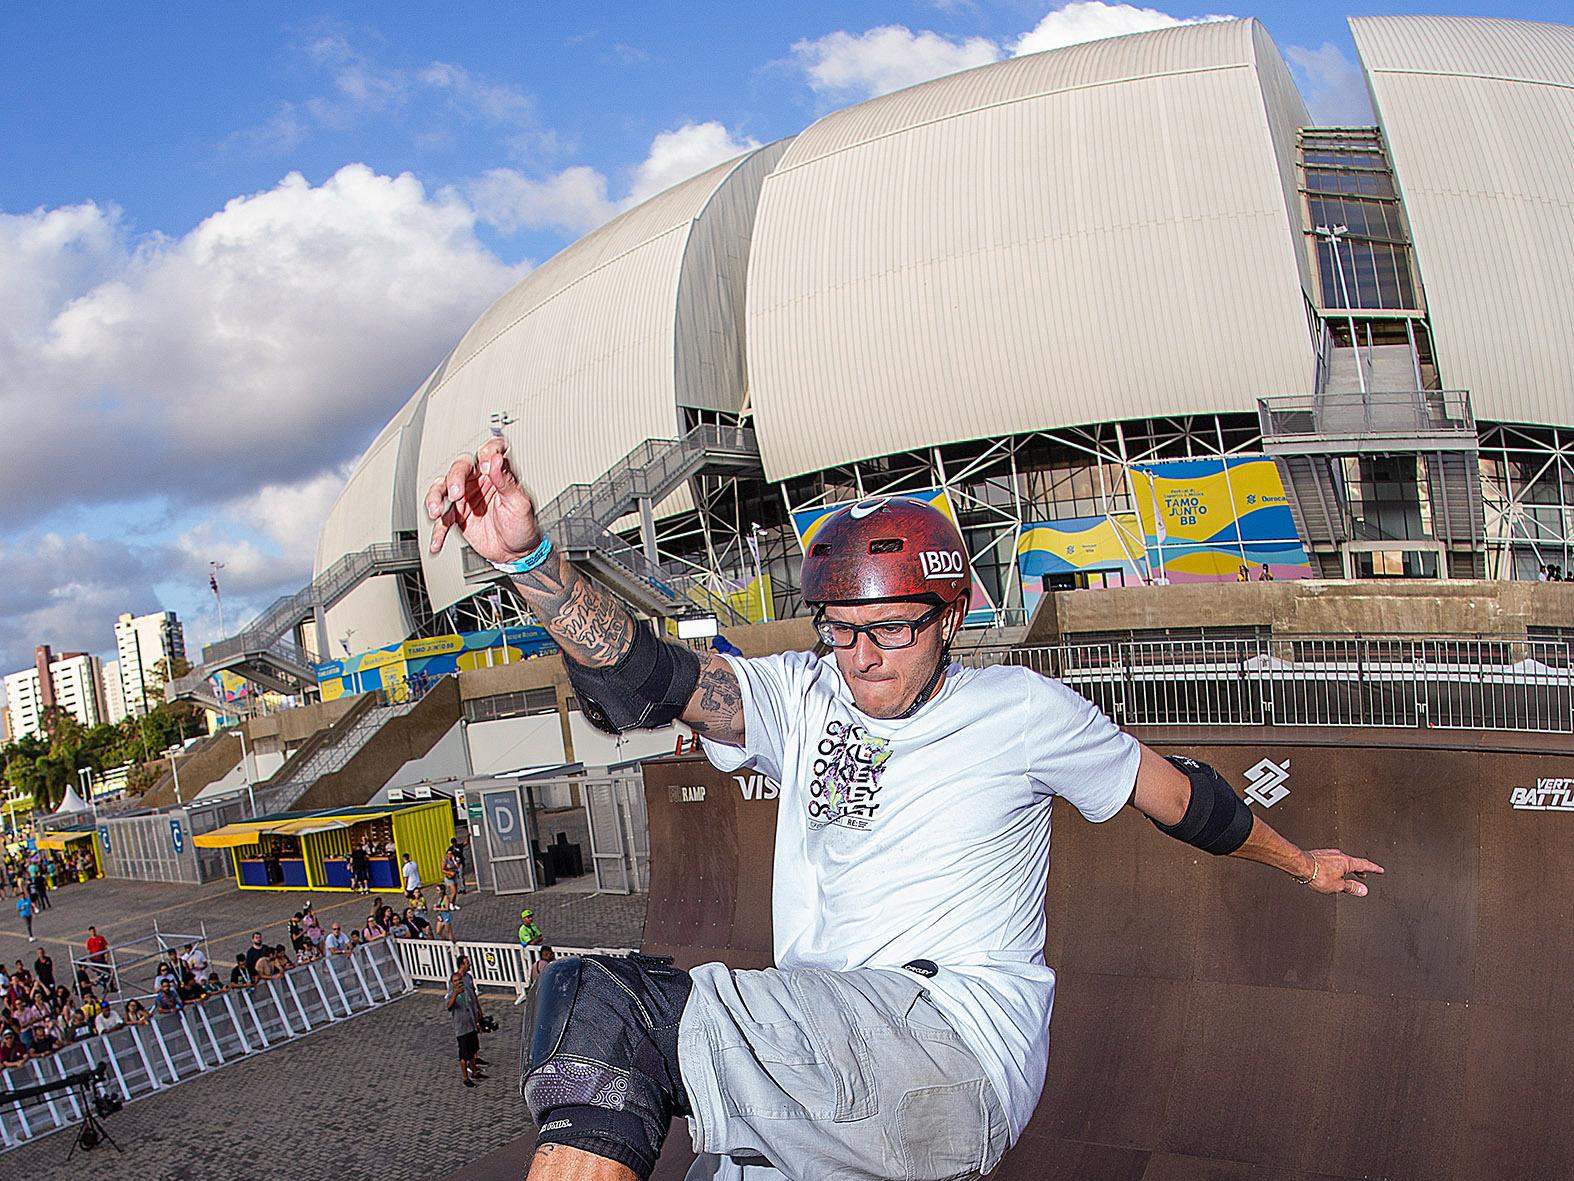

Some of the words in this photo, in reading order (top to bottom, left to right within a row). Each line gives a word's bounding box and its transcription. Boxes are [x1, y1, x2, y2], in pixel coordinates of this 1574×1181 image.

[1165, 498, 1199, 508] TAMO
[1169, 506, 1207, 516] JUNTO
[1180, 516, 1197, 525] BB
[925, 551, 963, 573] BDO
[732, 775, 780, 800] VIS
[1510, 787, 1574, 806] BATTL
[495, 806, 514, 833] D
[173, 828, 182, 847] C
